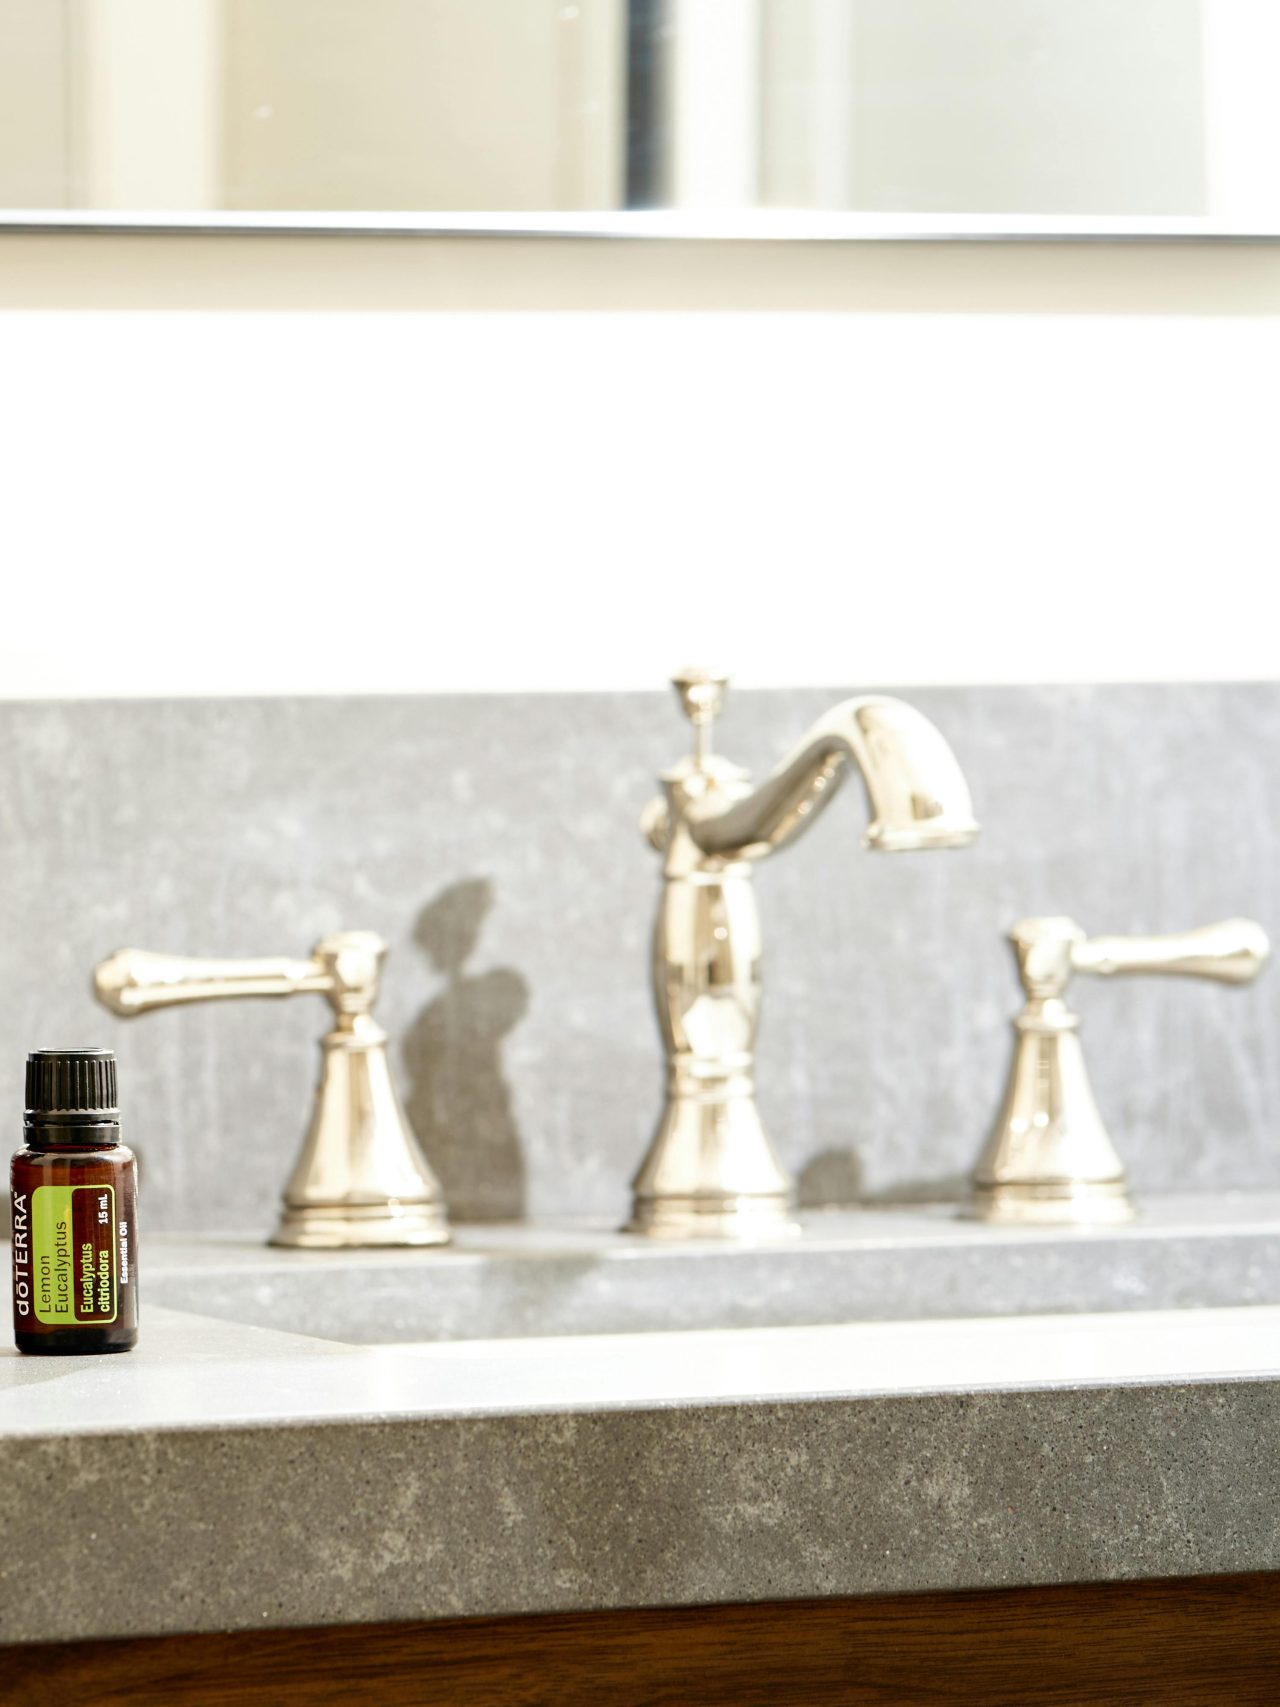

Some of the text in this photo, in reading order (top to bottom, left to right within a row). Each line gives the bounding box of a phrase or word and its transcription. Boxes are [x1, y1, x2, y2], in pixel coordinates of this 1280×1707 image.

[98, 1194, 108, 1224] 15 mL
[54, 1221, 71, 1313] Eucalyptus
[80, 1243, 95, 1313] Eucalyptus
[97, 1250, 110, 1313] citriodora
[120, 1221, 128, 1284] Essential Oil
[39, 1255, 51, 1314] Lemon
